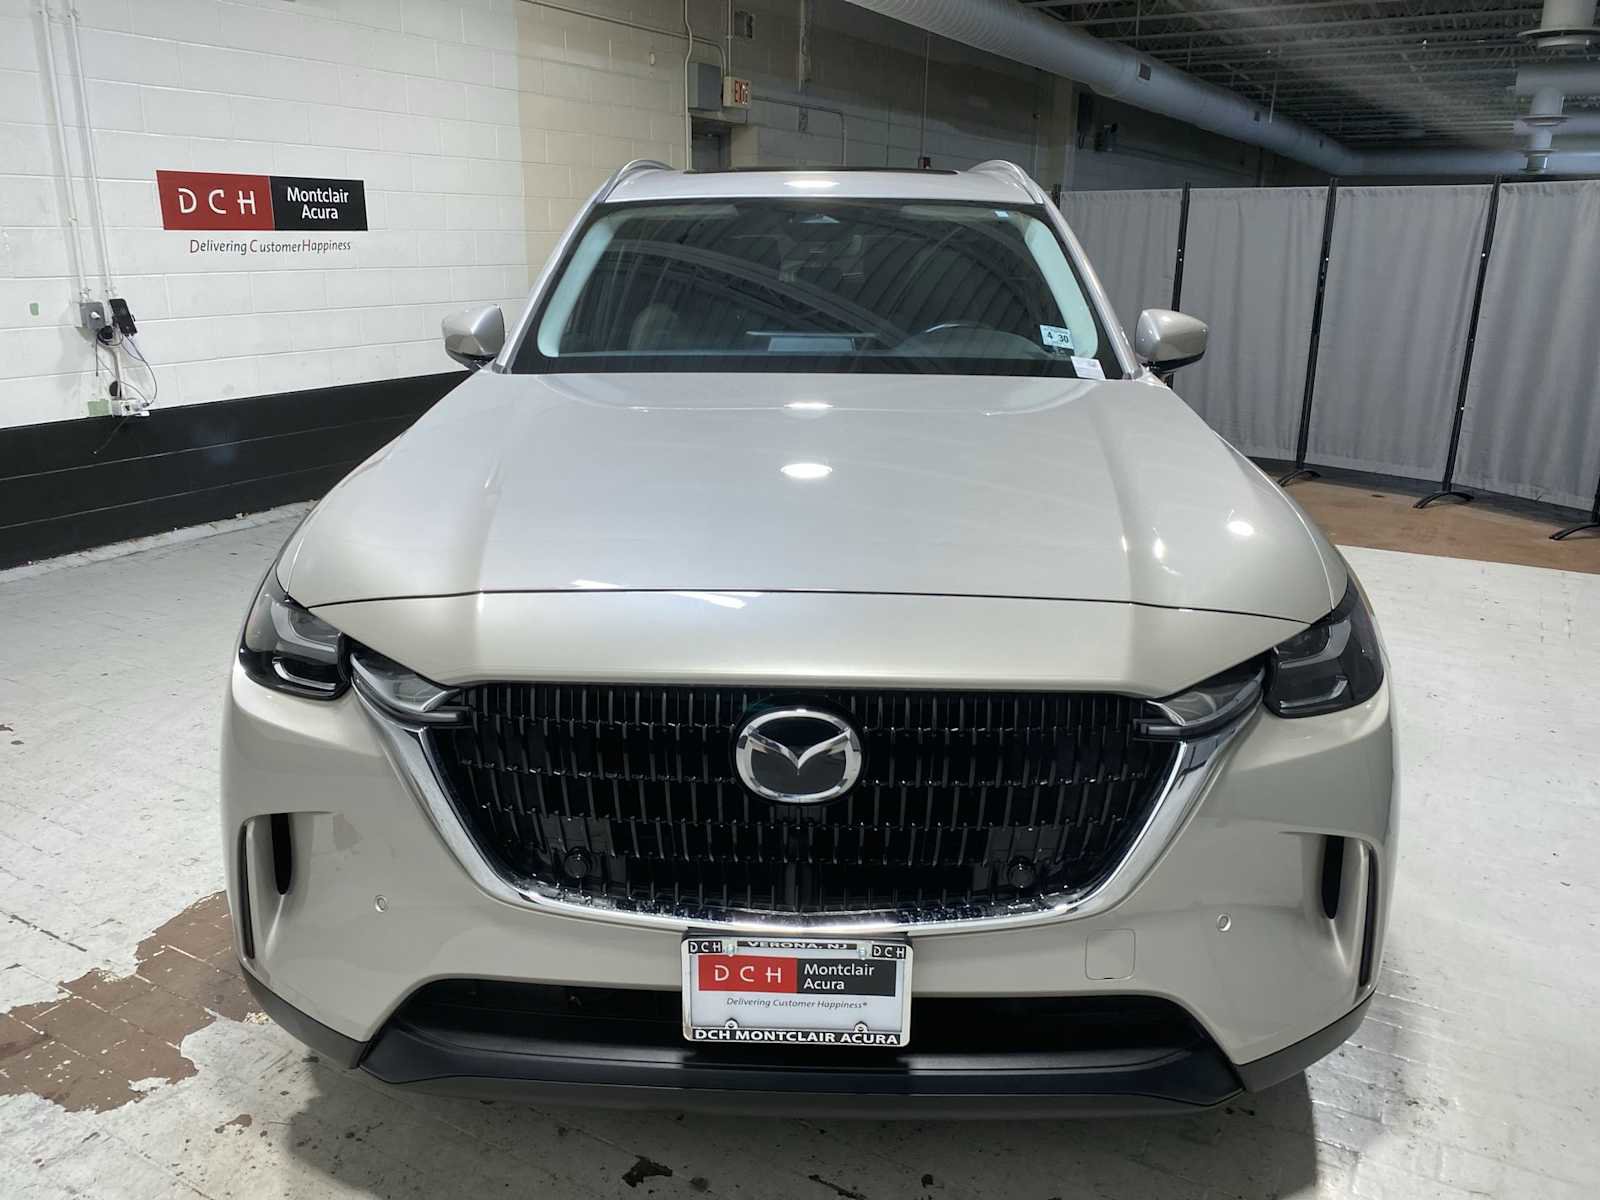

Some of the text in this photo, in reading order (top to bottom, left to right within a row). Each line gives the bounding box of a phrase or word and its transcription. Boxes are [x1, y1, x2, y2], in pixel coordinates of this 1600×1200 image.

[287, 187, 349, 203] Montclair
[301, 204, 338, 219] Acura
[190, 240, 351, 255] Delivering Customer Happiness
[690, 942, 721, 953] DCH
[873, 946, 905, 958] DCH
[714, 965, 782, 984] DCH
[804, 963, 875, 976] Montclair
[803, 978, 845, 990] Acura
[726, 998, 770, 1008] Delivering
[773, 1000, 815, 1008] Customer
[695, 1030, 898, 1045] DCH MONTCLAIR ACURA
